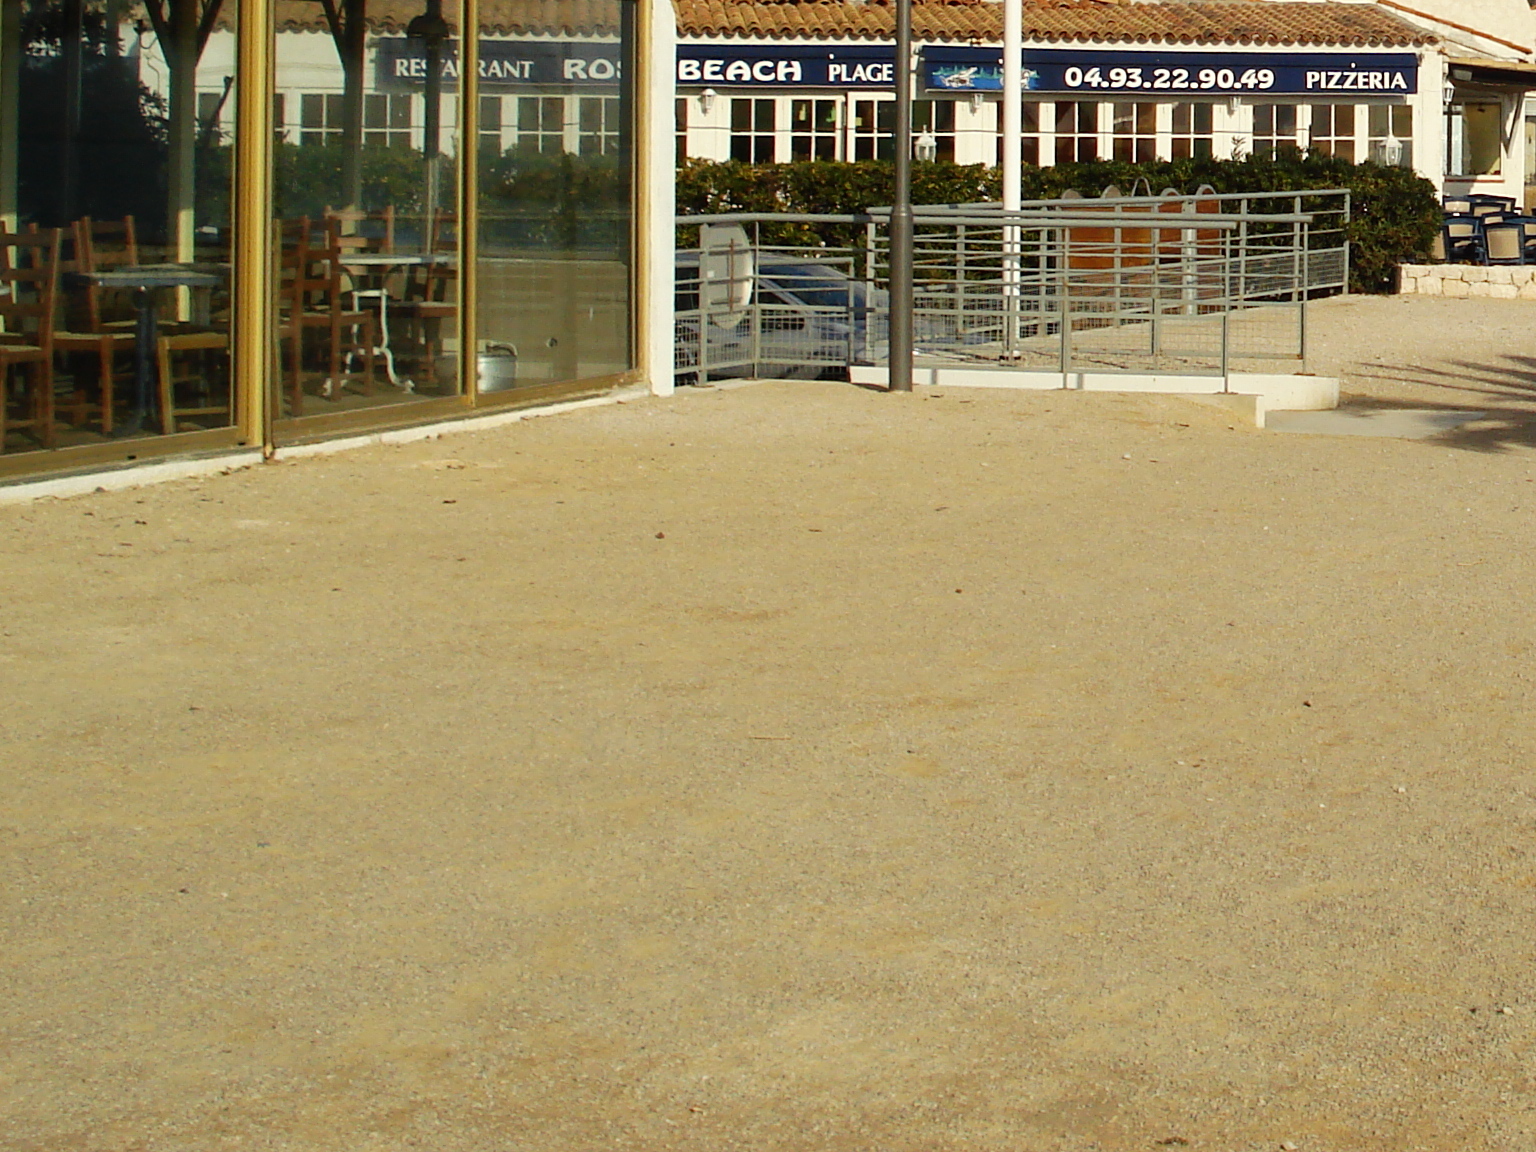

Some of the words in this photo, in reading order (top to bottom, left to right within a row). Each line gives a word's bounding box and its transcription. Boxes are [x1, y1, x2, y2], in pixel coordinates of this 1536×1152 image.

[563, 58, 621, 79] RO
[678, 59, 802, 81] BEACH
[828, 63, 893, 82] PLAGE
[1064, 66, 1275, 89] 04.93.22.90.49
[1306, 71, 1407, 90] PIZZERIA
